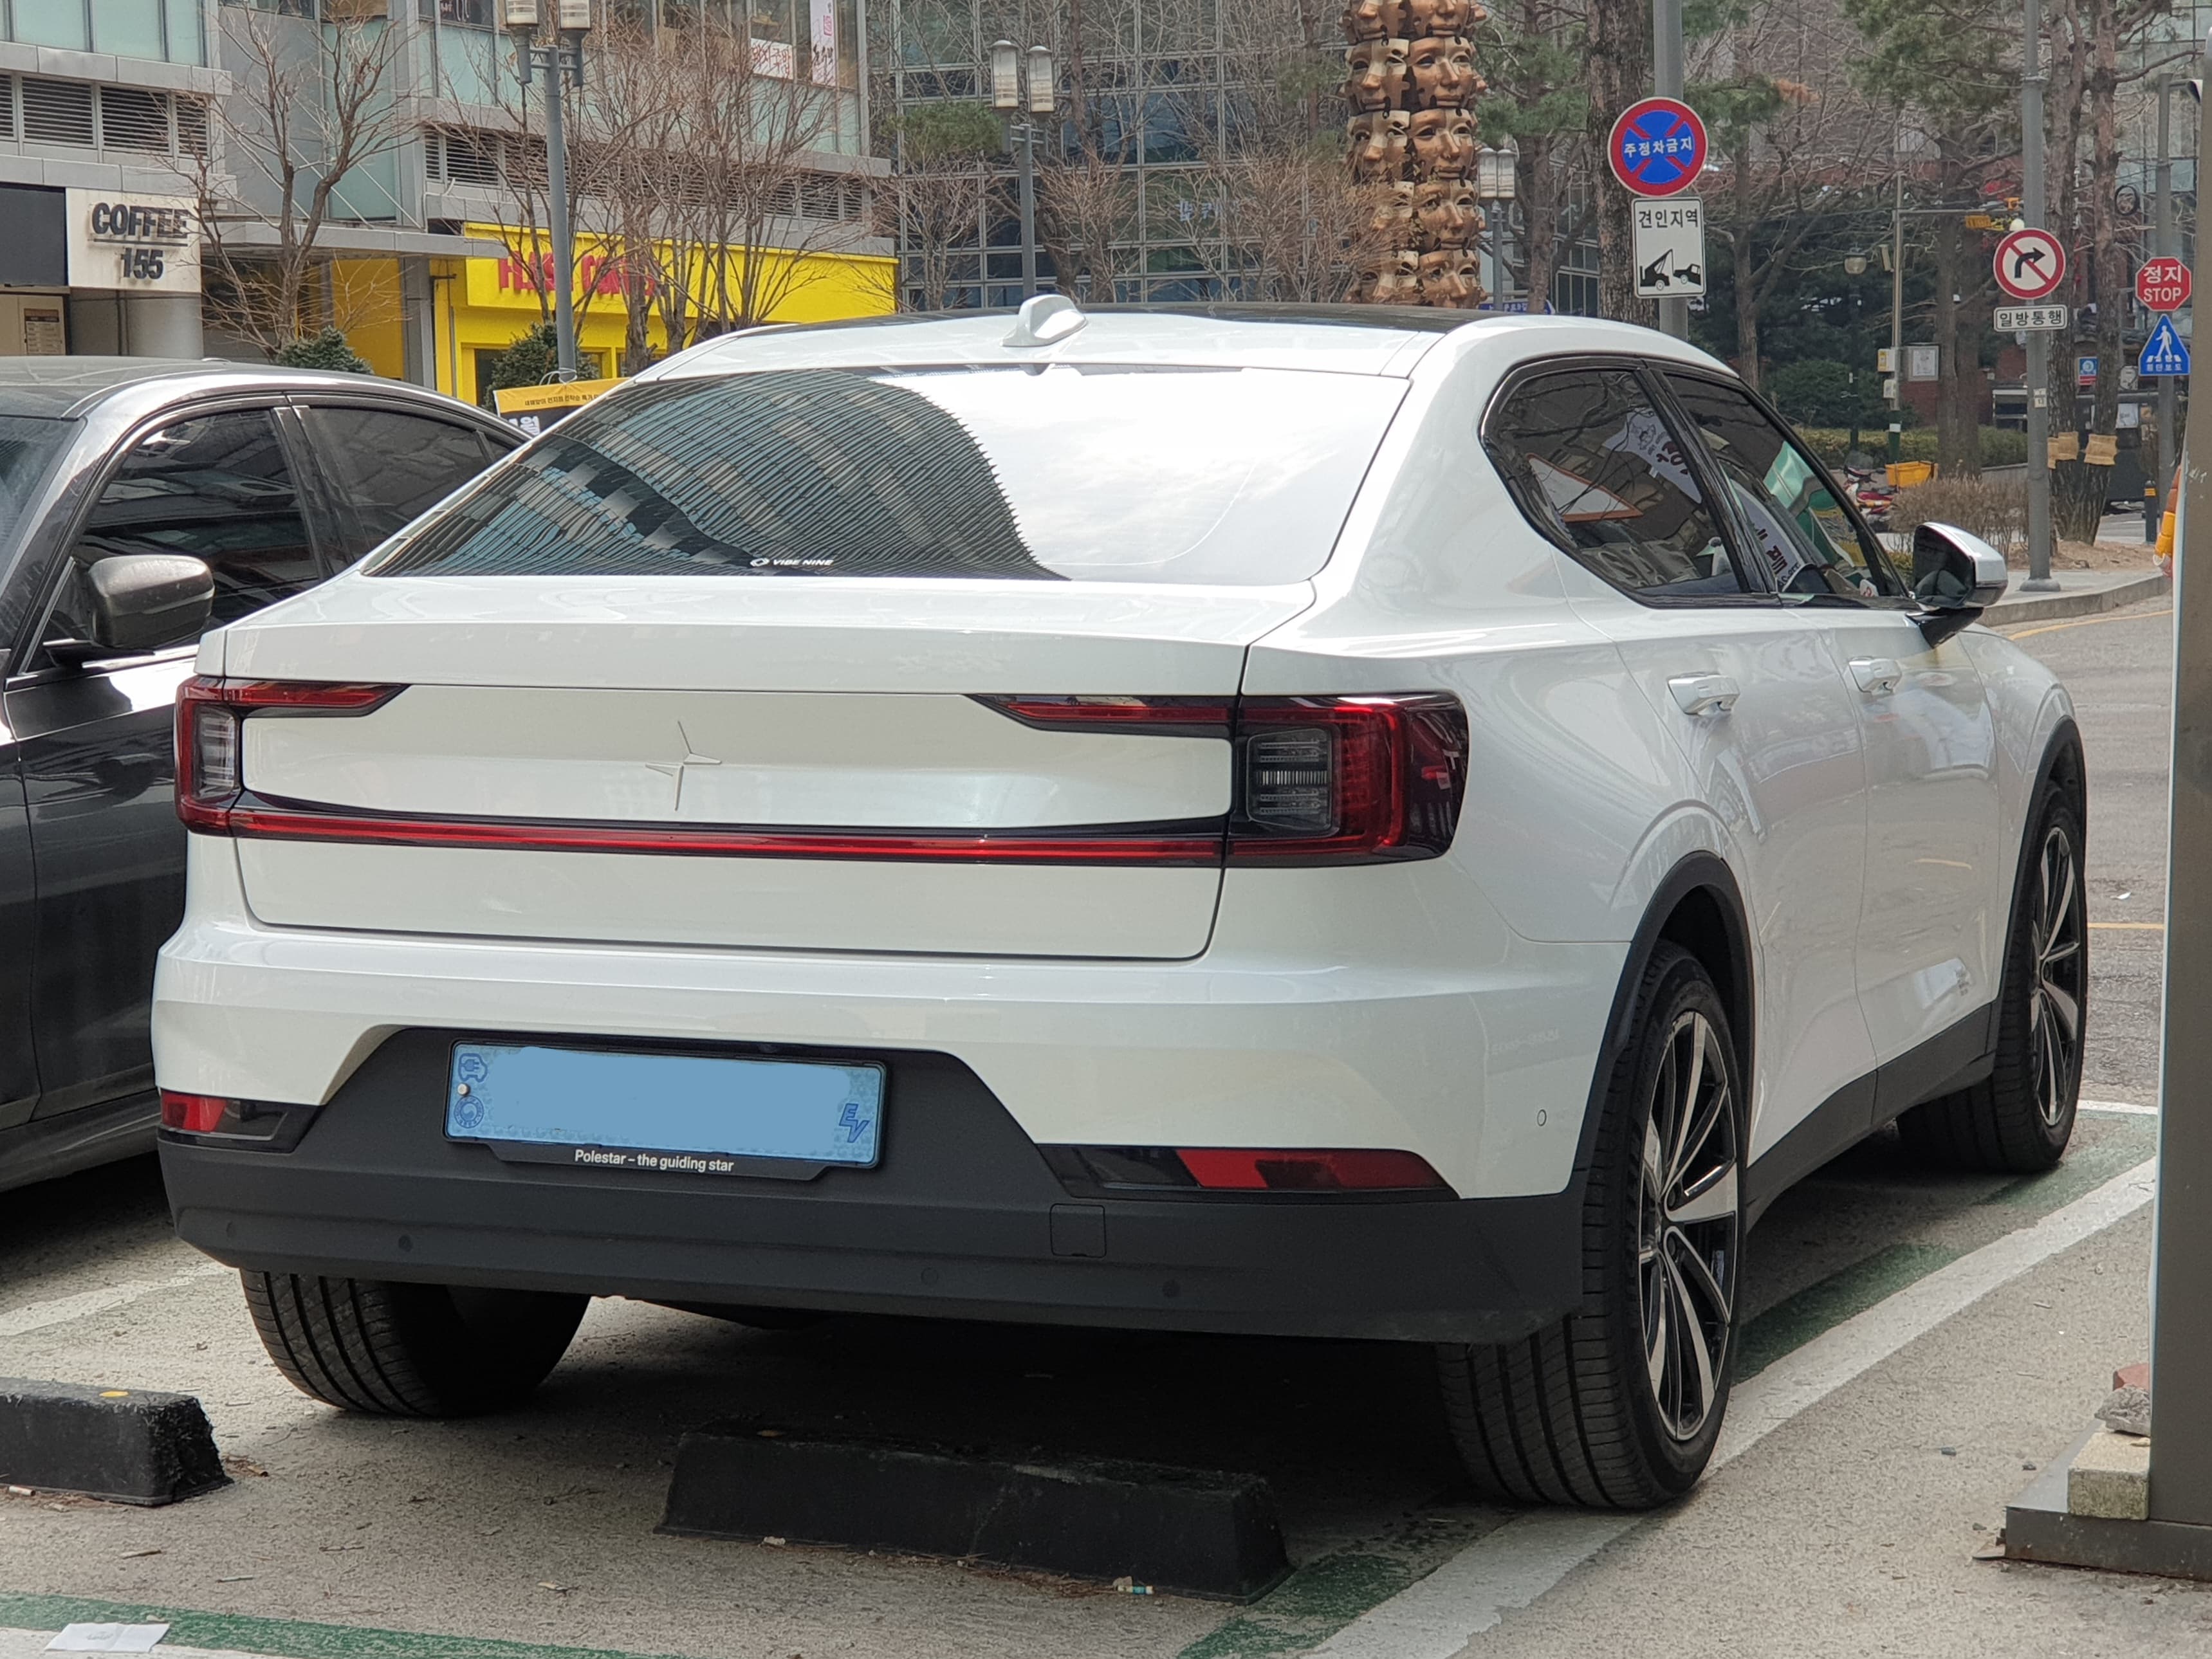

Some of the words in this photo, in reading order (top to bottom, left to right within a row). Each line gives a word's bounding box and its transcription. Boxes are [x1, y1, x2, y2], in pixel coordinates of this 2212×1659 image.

[1623, 136, 1693, 158] 주정차금지
[92, 202, 189, 239] COFFEE
[1638, 208, 1699, 229] 견인지역
[120, 247, 163, 279] 155
[2143, 265, 2182, 284] 정지
[2143, 288, 2182, 302] STOP
[1999, 309, 2063, 327] 일방통행
[838, 1103, 871, 1143] EV
[575, 1149, 626, 1165] Polestar
[637, 1153, 658, 1168] the
[659, 1155, 706, 1173] guiding
[708, 1160, 735, 1172] star
